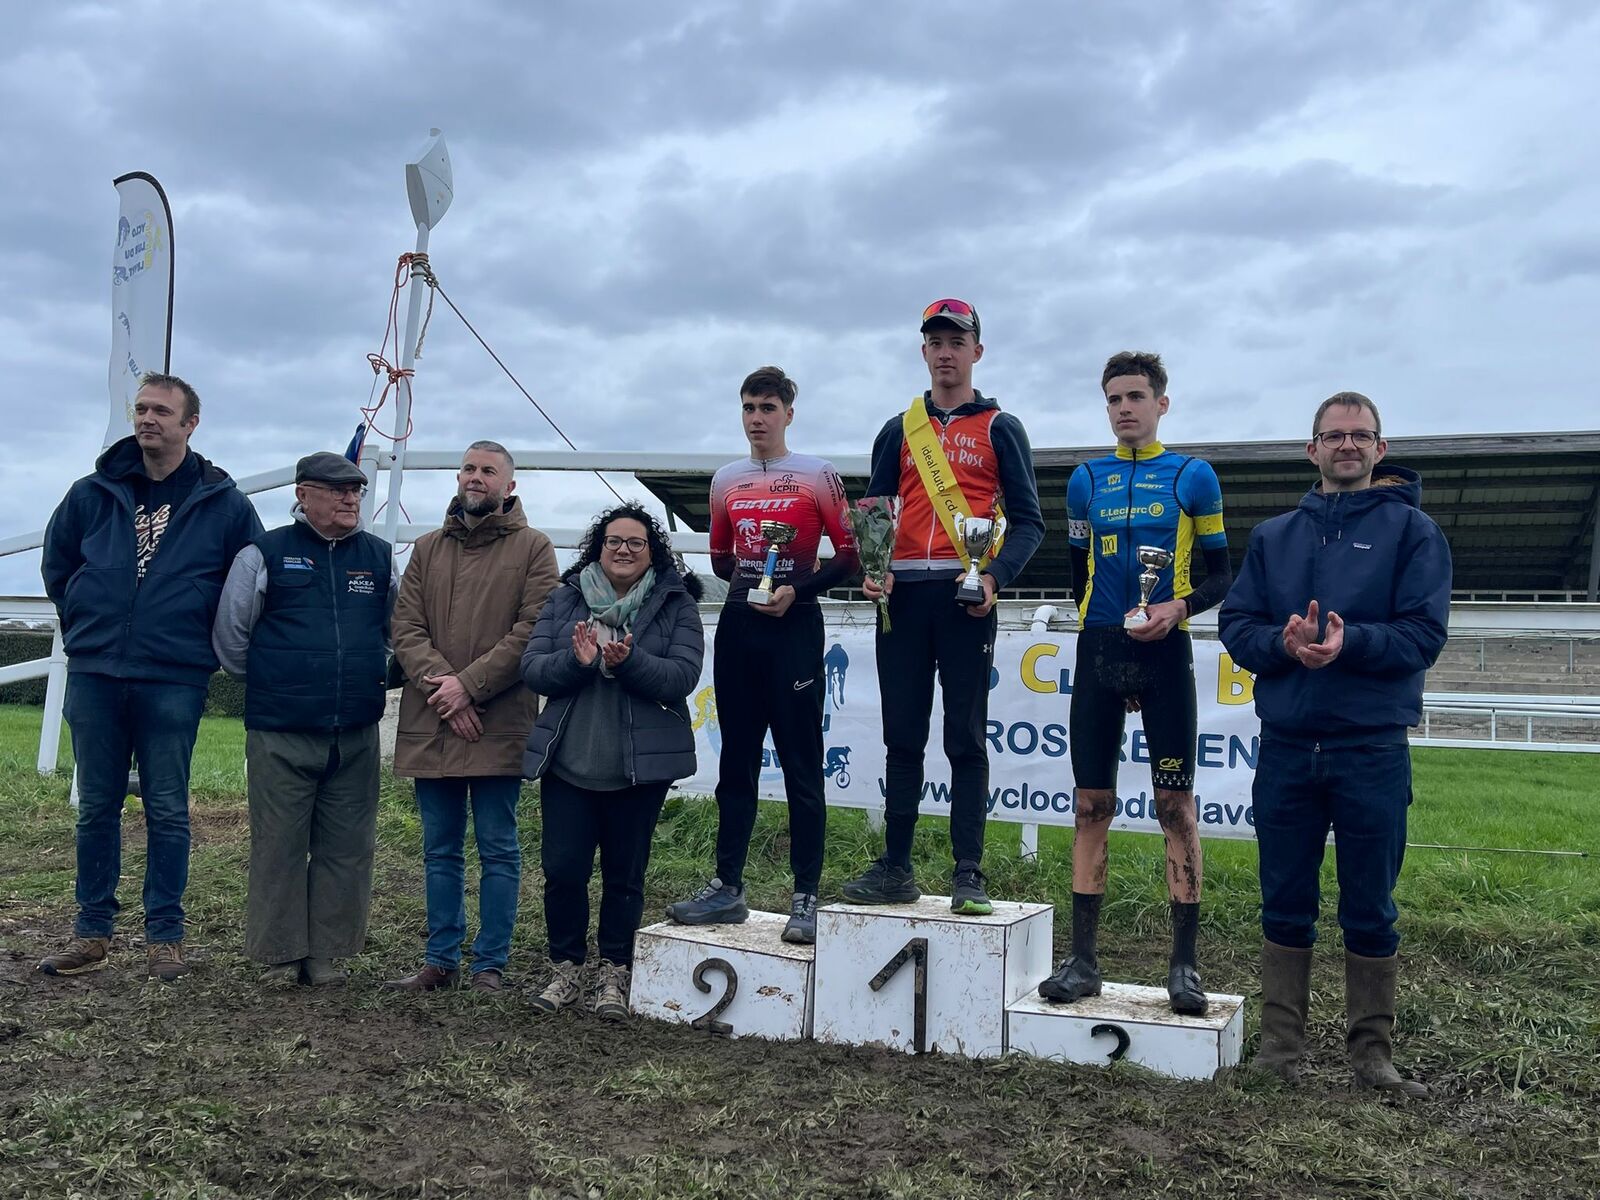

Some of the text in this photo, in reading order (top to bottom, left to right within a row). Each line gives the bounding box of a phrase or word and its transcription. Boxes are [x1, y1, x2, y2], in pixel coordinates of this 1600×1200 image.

[921, 445, 938, 469] ideal
[959, 449, 984, 468] ROSE
[731, 498, 800, 510] GIANT
[1100, 507, 1148, 518] E.Leclerc
[692, 957, 739, 1034] 2
[869, 937, 929, 1052] 1
